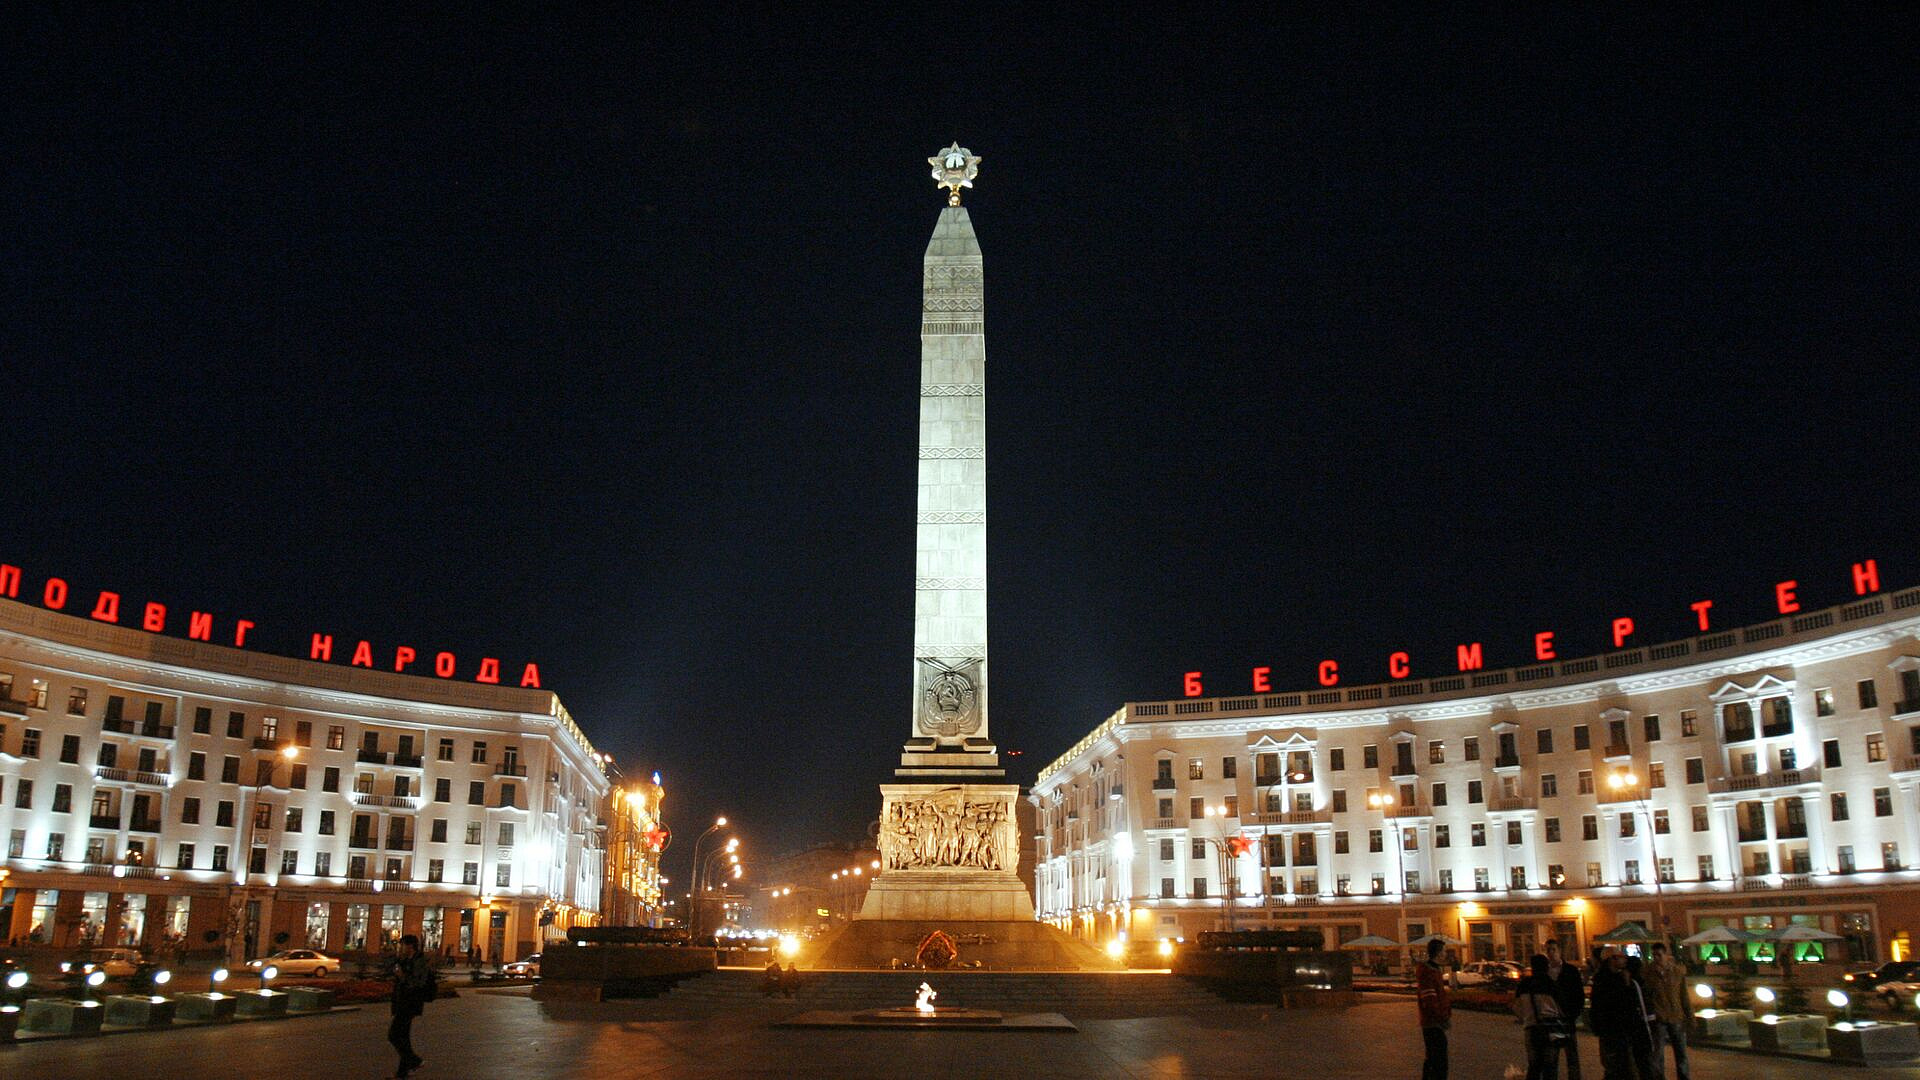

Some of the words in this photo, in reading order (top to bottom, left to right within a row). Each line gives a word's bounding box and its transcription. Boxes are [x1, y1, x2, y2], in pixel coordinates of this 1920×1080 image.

[0, 564, 254, 647] ПОДВИГ
[311, 633, 540, 689] НАРОДА
[1184, 559, 1880, 697] БЕССМЕРТЕН
